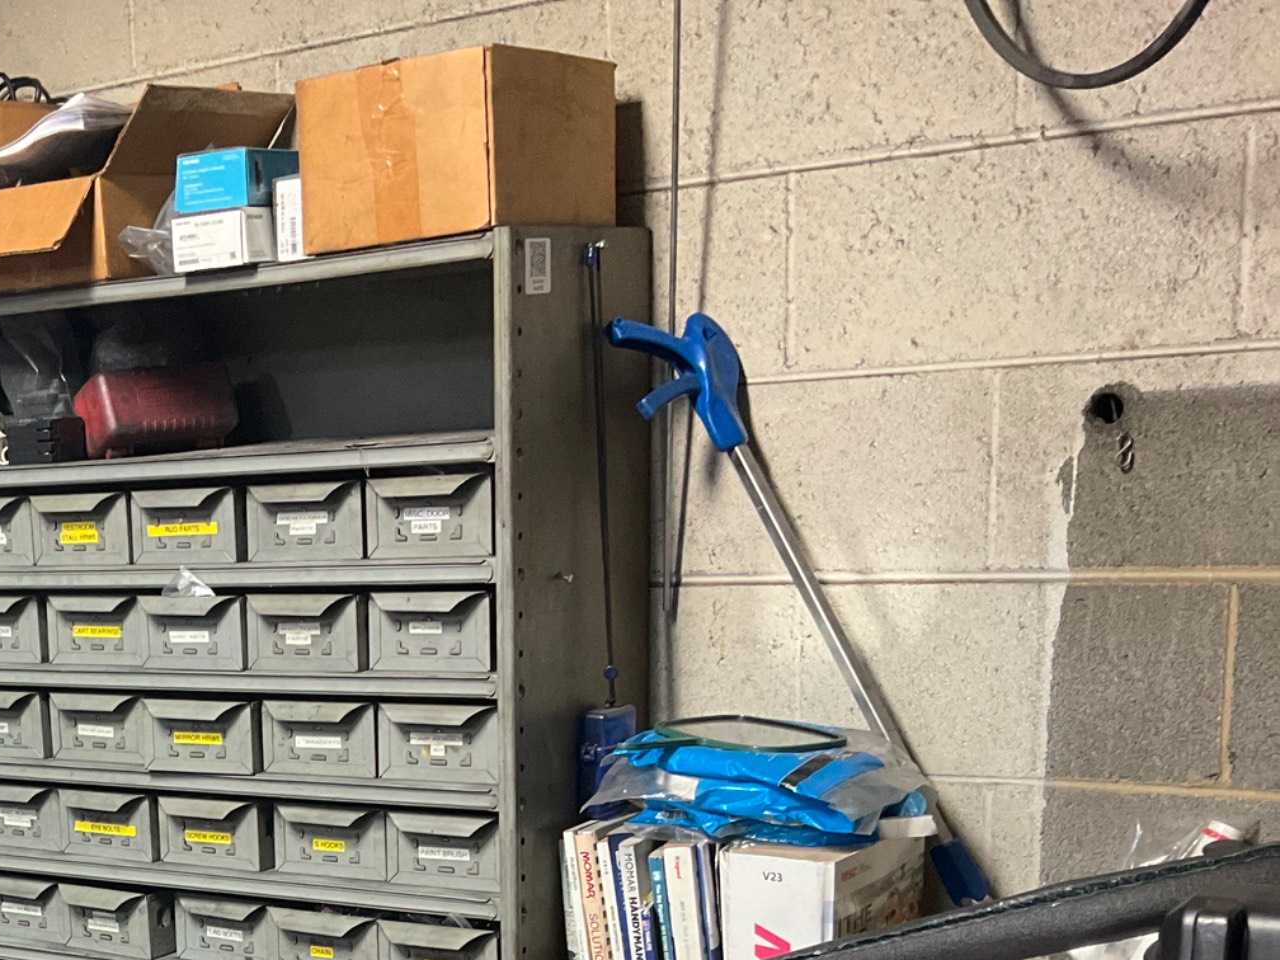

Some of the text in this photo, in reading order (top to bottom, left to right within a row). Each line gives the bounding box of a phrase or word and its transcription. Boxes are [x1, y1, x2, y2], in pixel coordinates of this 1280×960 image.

[413, 522, 438, 530] PARTS
[624, 853, 637, 893] MOMAR
[762, 871, 784, 883] V23
[629, 896, 645, 960] HANDYMAN
